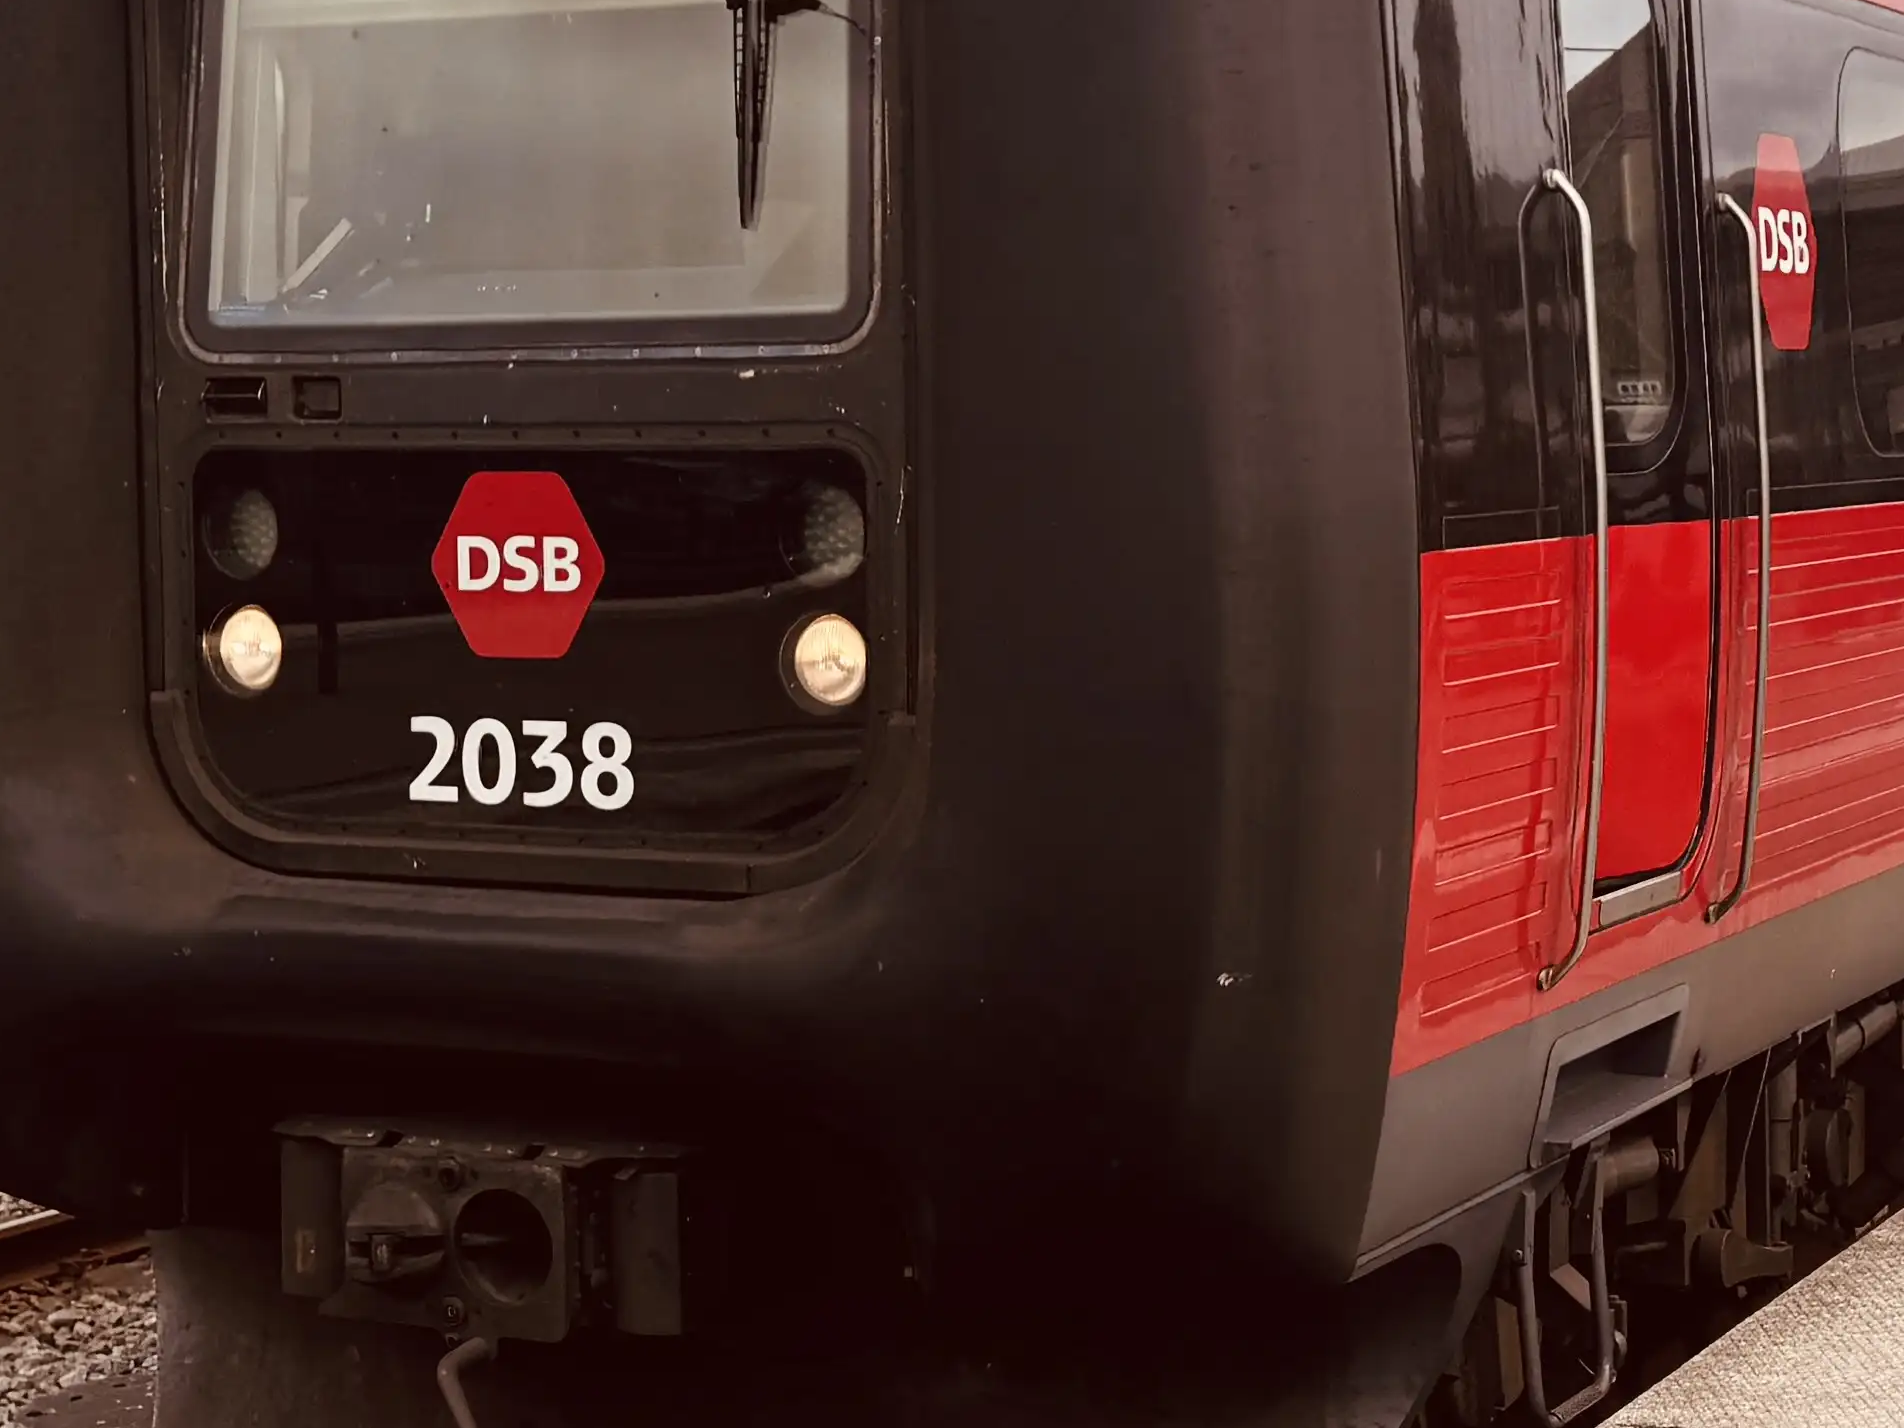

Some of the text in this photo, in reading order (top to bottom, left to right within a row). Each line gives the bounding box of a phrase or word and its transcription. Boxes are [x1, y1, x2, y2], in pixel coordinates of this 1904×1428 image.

[1758, 206, 1810, 274] DSB
[457, 535, 581, 592] DSB
[409, 715, 634, 811] 2038
